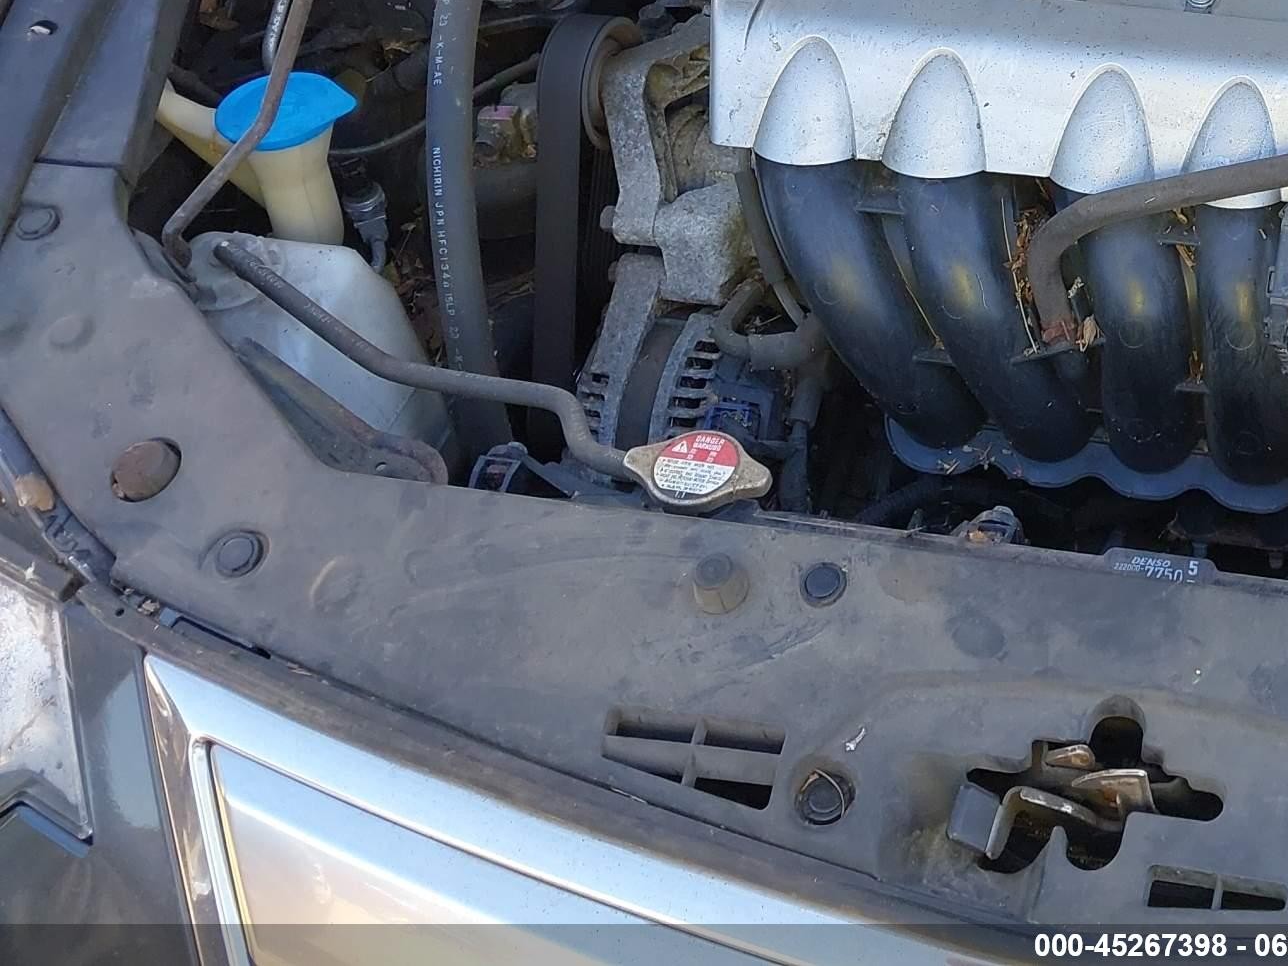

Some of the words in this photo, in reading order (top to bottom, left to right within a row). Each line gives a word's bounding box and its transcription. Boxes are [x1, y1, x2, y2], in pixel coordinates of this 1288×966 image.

[432, 147, 443, 196] NICHIRIN
[435, 201, 445, 226] JPN
[695, 435, 726, 445] DANGER
[1131, 556, 1171, 568] DENSO
